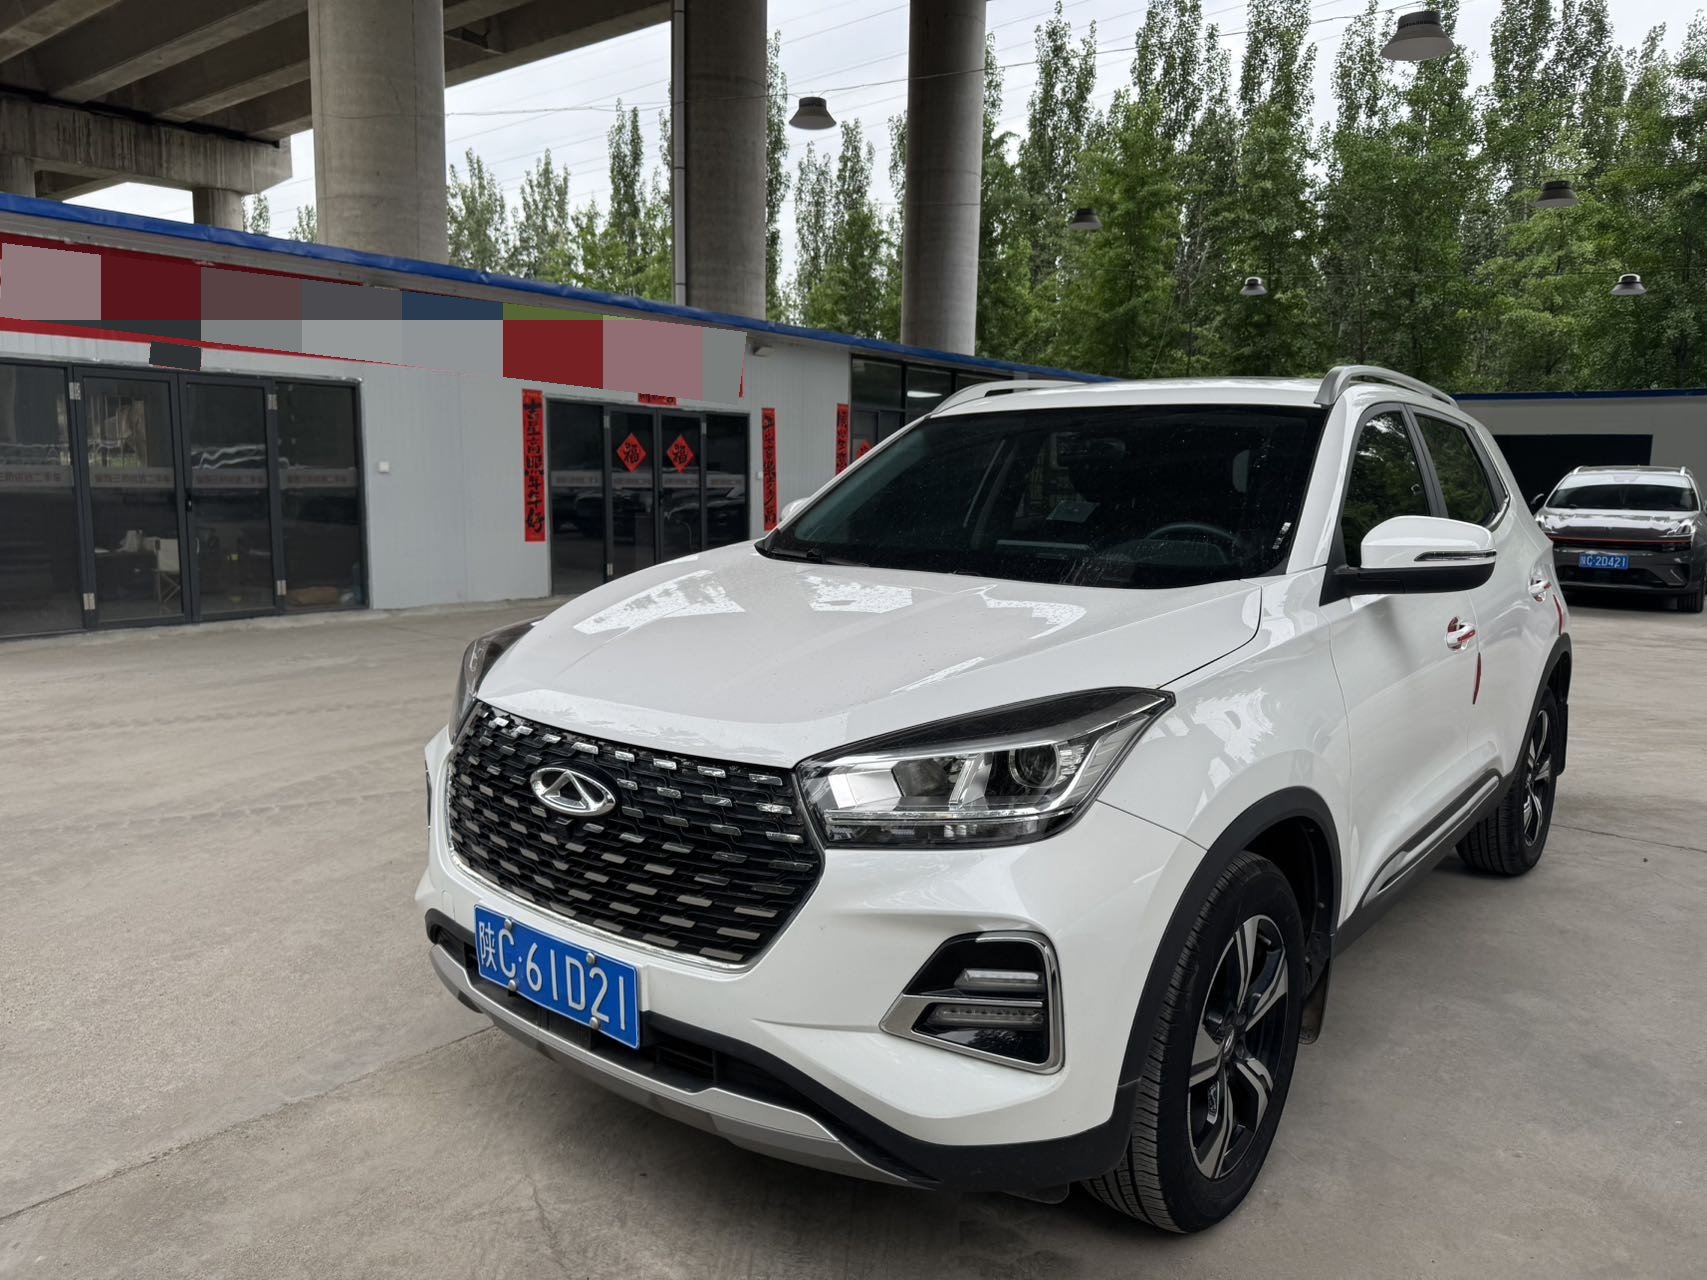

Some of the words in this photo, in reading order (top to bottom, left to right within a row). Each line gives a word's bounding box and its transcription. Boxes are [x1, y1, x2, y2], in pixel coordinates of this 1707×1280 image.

[623, 442, 639, 464] 福
[671, 443, 688, 464] 福
[478, 921, 626, 1031] 陕C·61D21
